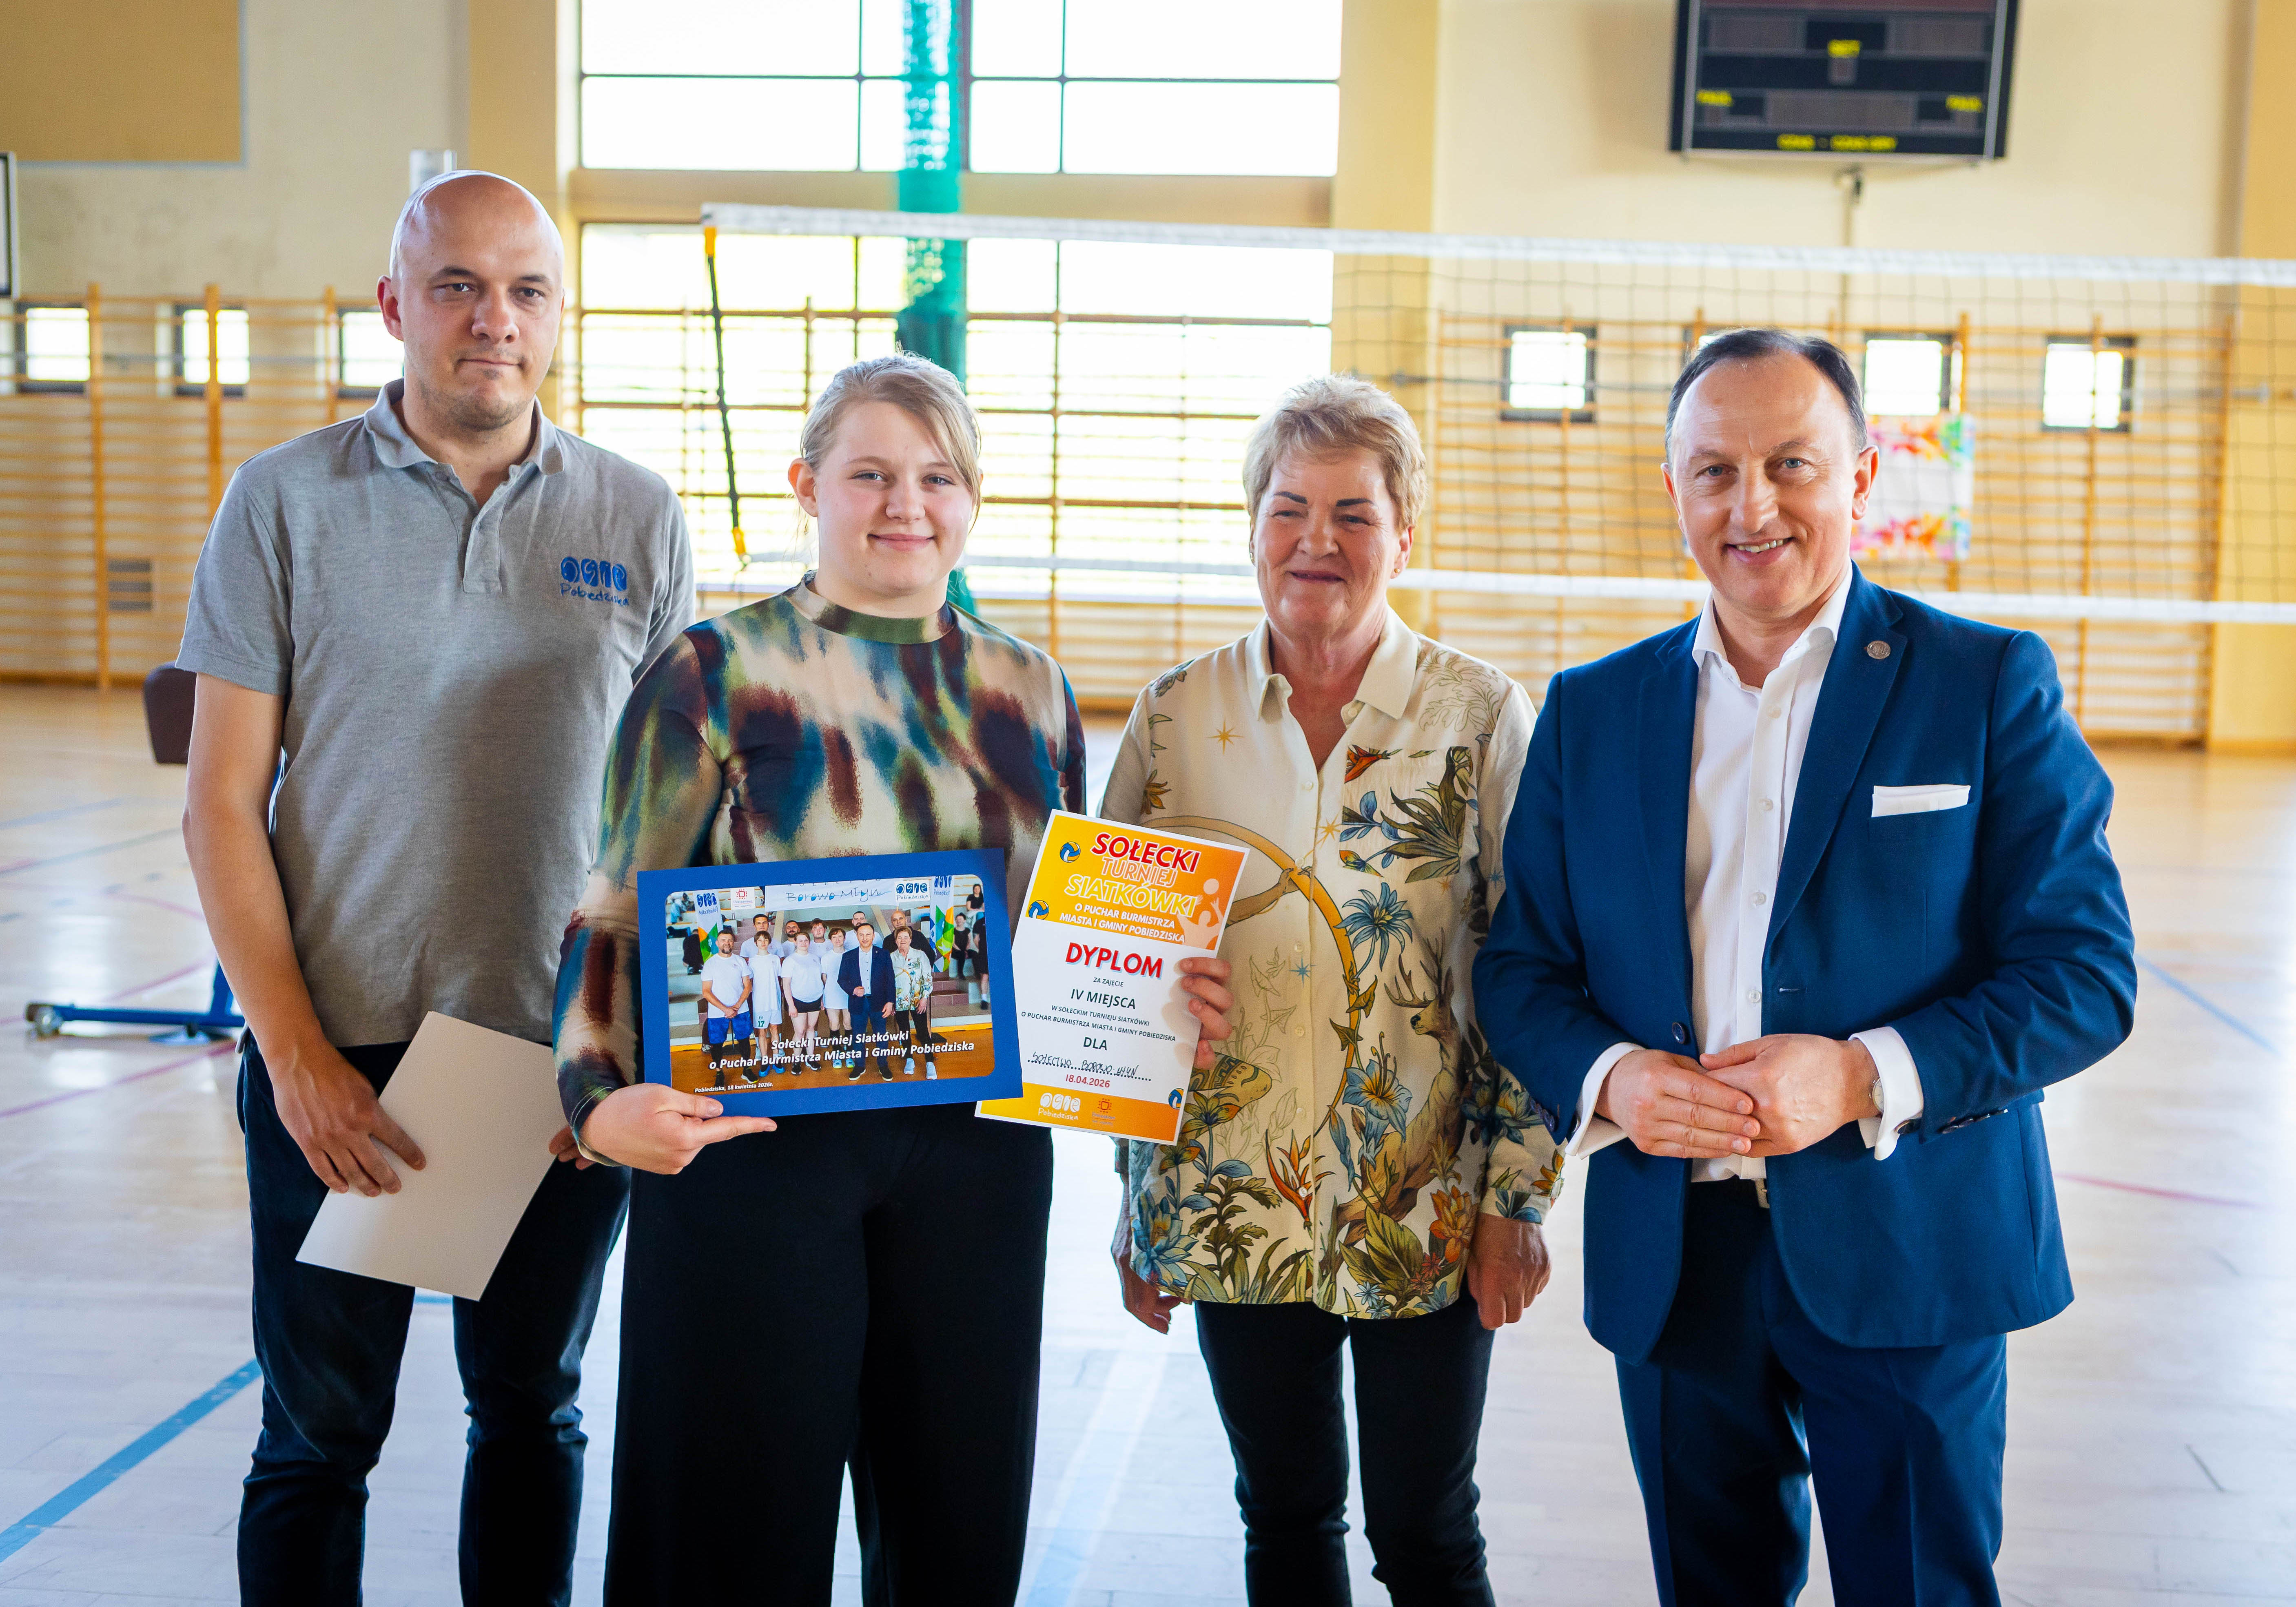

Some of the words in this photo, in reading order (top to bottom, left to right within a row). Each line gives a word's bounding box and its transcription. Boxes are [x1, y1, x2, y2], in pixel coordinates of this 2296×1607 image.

[1090, 832, 1201, 874] SOŁECKI
[1101, 857, 1178, 888] TURNIEJ
[786, 892, 835, 902] Borowo
[1064, 874, 1198, 918] SIATKÓWKI
[1075, 903, 1083, 911] O
[1084, 905, 1119, 919] PUCHAR
[1121, 912, 1175, 929] BURMISTRZA
[1059, 913, 1092, 926] MIASTA
[1099, 920, 1129, 932] GMINY
[1129, 925, 1186, 943] POBIEDZISKA
[1065, 941, 1164, 979] DYPLOM
[1102, 978, 1124, 987] ZAJĘCIE
[1071, 988, 1084, 1000] IV
[1086, 992, 1136, 1009] MIEJSCA
[1027, 1012, 1052, 1021] PUCHAR
[1053, 1016, 1090, 1027] BURMISTRZA
[1091, 1023, 1113, 1032] MIASTA
[1118, 1027, 1138, 1036] GMINY
[1139, 1031, 1176, 1042] POBIEDZISKA
[1058, 1006, 1088, 1016] SOŁECKIM
[1089, 1011, 1117, 1021] TURNIEJU
[1118, 1016, 1150, 1026] SIATKÓWKI
[771, 1038, 810, 1050] Sołecki
[814, 1034, 853, 1047] Turniej
[855, 1030, 909, 1044] Siatkówki
[1083, 1036, 1108, 1051] DLA
[720, 1057, 758, 1068] Puchar
[761, 1053, 821, 1065] Burmistrza
[824, 1049, 862, 1060] Miasta
[865, 1048, 869, 1057] i
[872, 1046, 907, 1058] Gminy
[910, 1040, 975, 1054] Pobiedziska
[1066, 1074, 1110, 1088] 18.04.2026
[1038, 1107, 1078, 1121] Pobiedziska
